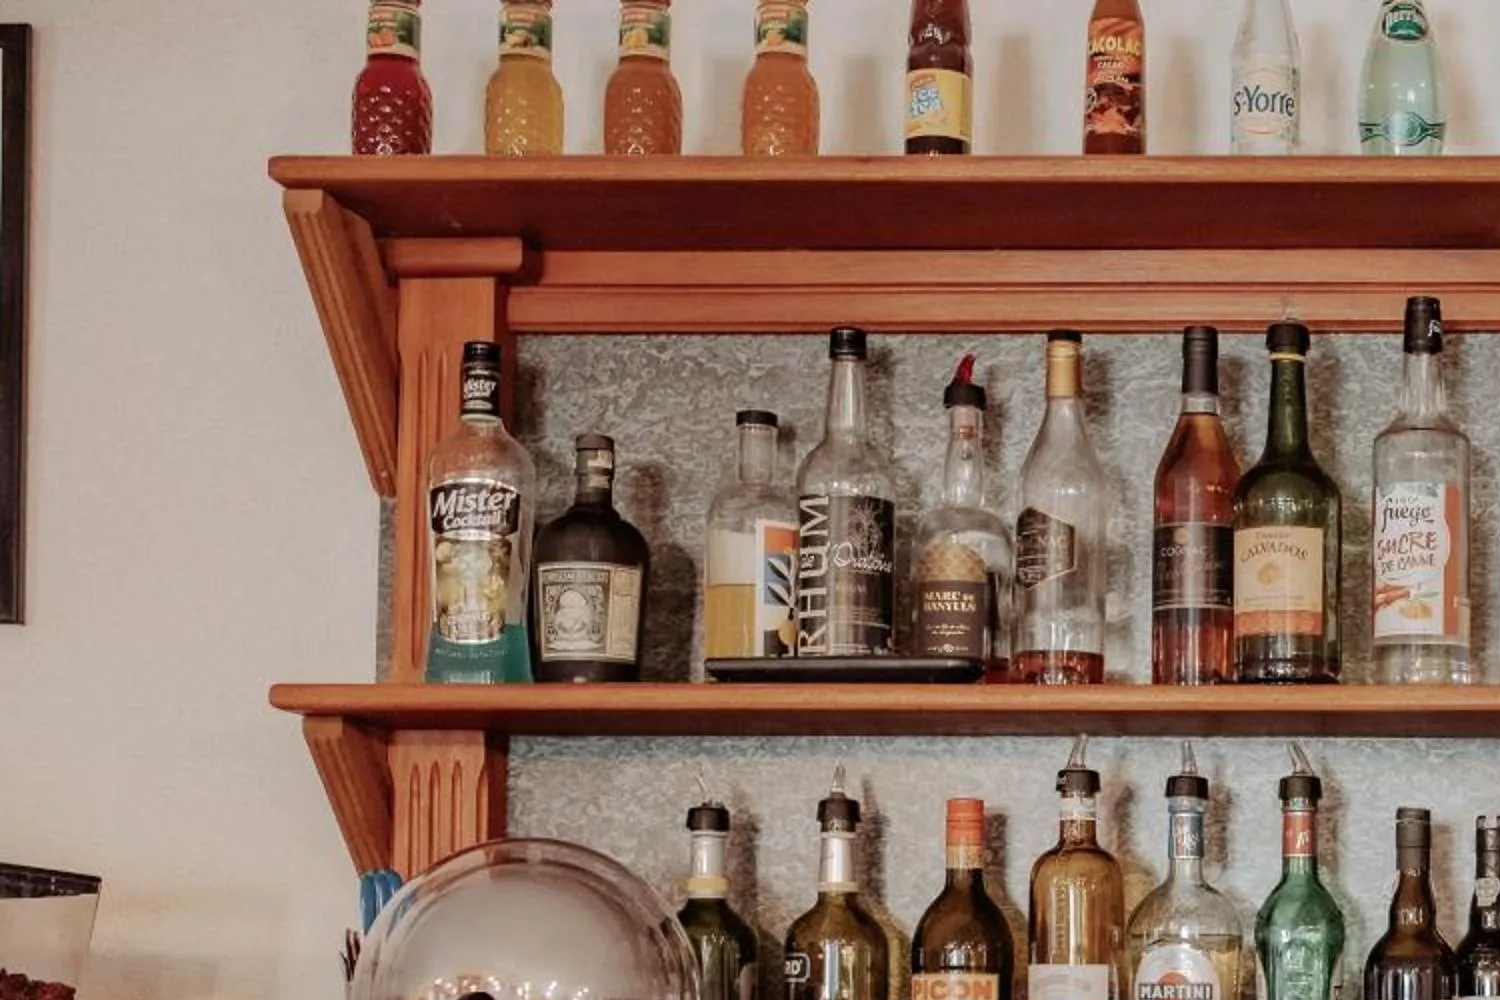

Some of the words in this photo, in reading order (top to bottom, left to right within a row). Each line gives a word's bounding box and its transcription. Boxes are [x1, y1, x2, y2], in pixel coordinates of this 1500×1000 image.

[433, 484, 518, 516] Mister
[1381, 497, 1435, 533] fuego
[799, 495, 830, 655] RHUM
[912, 979, 994, 1000] PICON
[1140, 984, 1213, 1000] MARTINI
